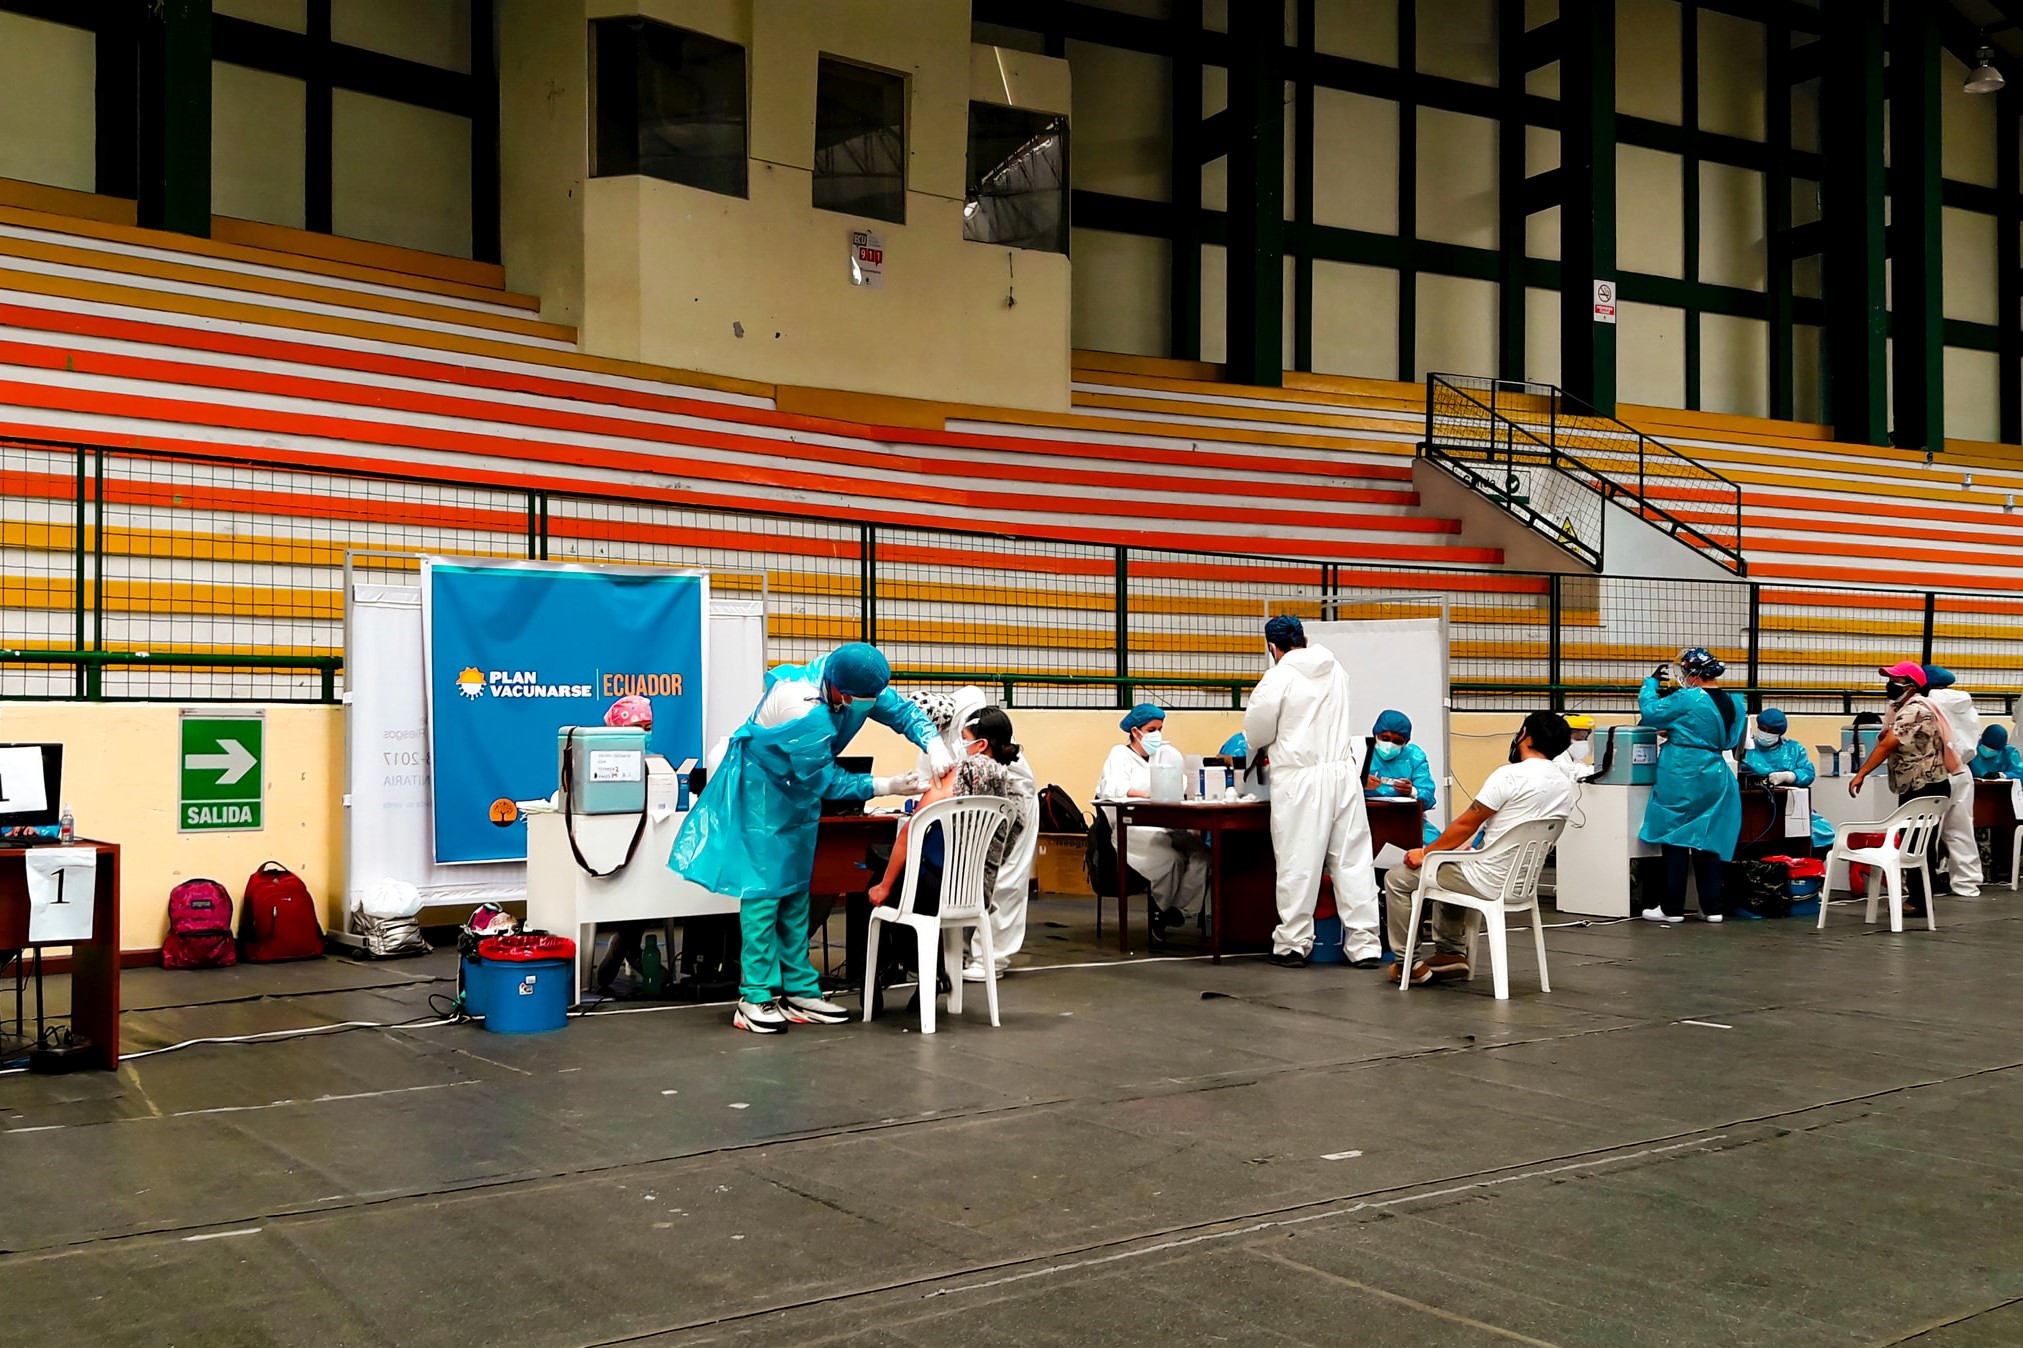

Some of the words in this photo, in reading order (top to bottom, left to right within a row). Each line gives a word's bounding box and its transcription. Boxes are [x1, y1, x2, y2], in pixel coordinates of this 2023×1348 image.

[854, 234, 867, 244] ECU
[860, 249, 881, 261] 911
[489, 671, 537, 684] PLAN
[489, 685, 592, 698] VACUNARSE
[603, 673, 683, 697] ECUADOR
[187, 805, 253, 824] SALIDA
[50, 868, 71, 905] 1
